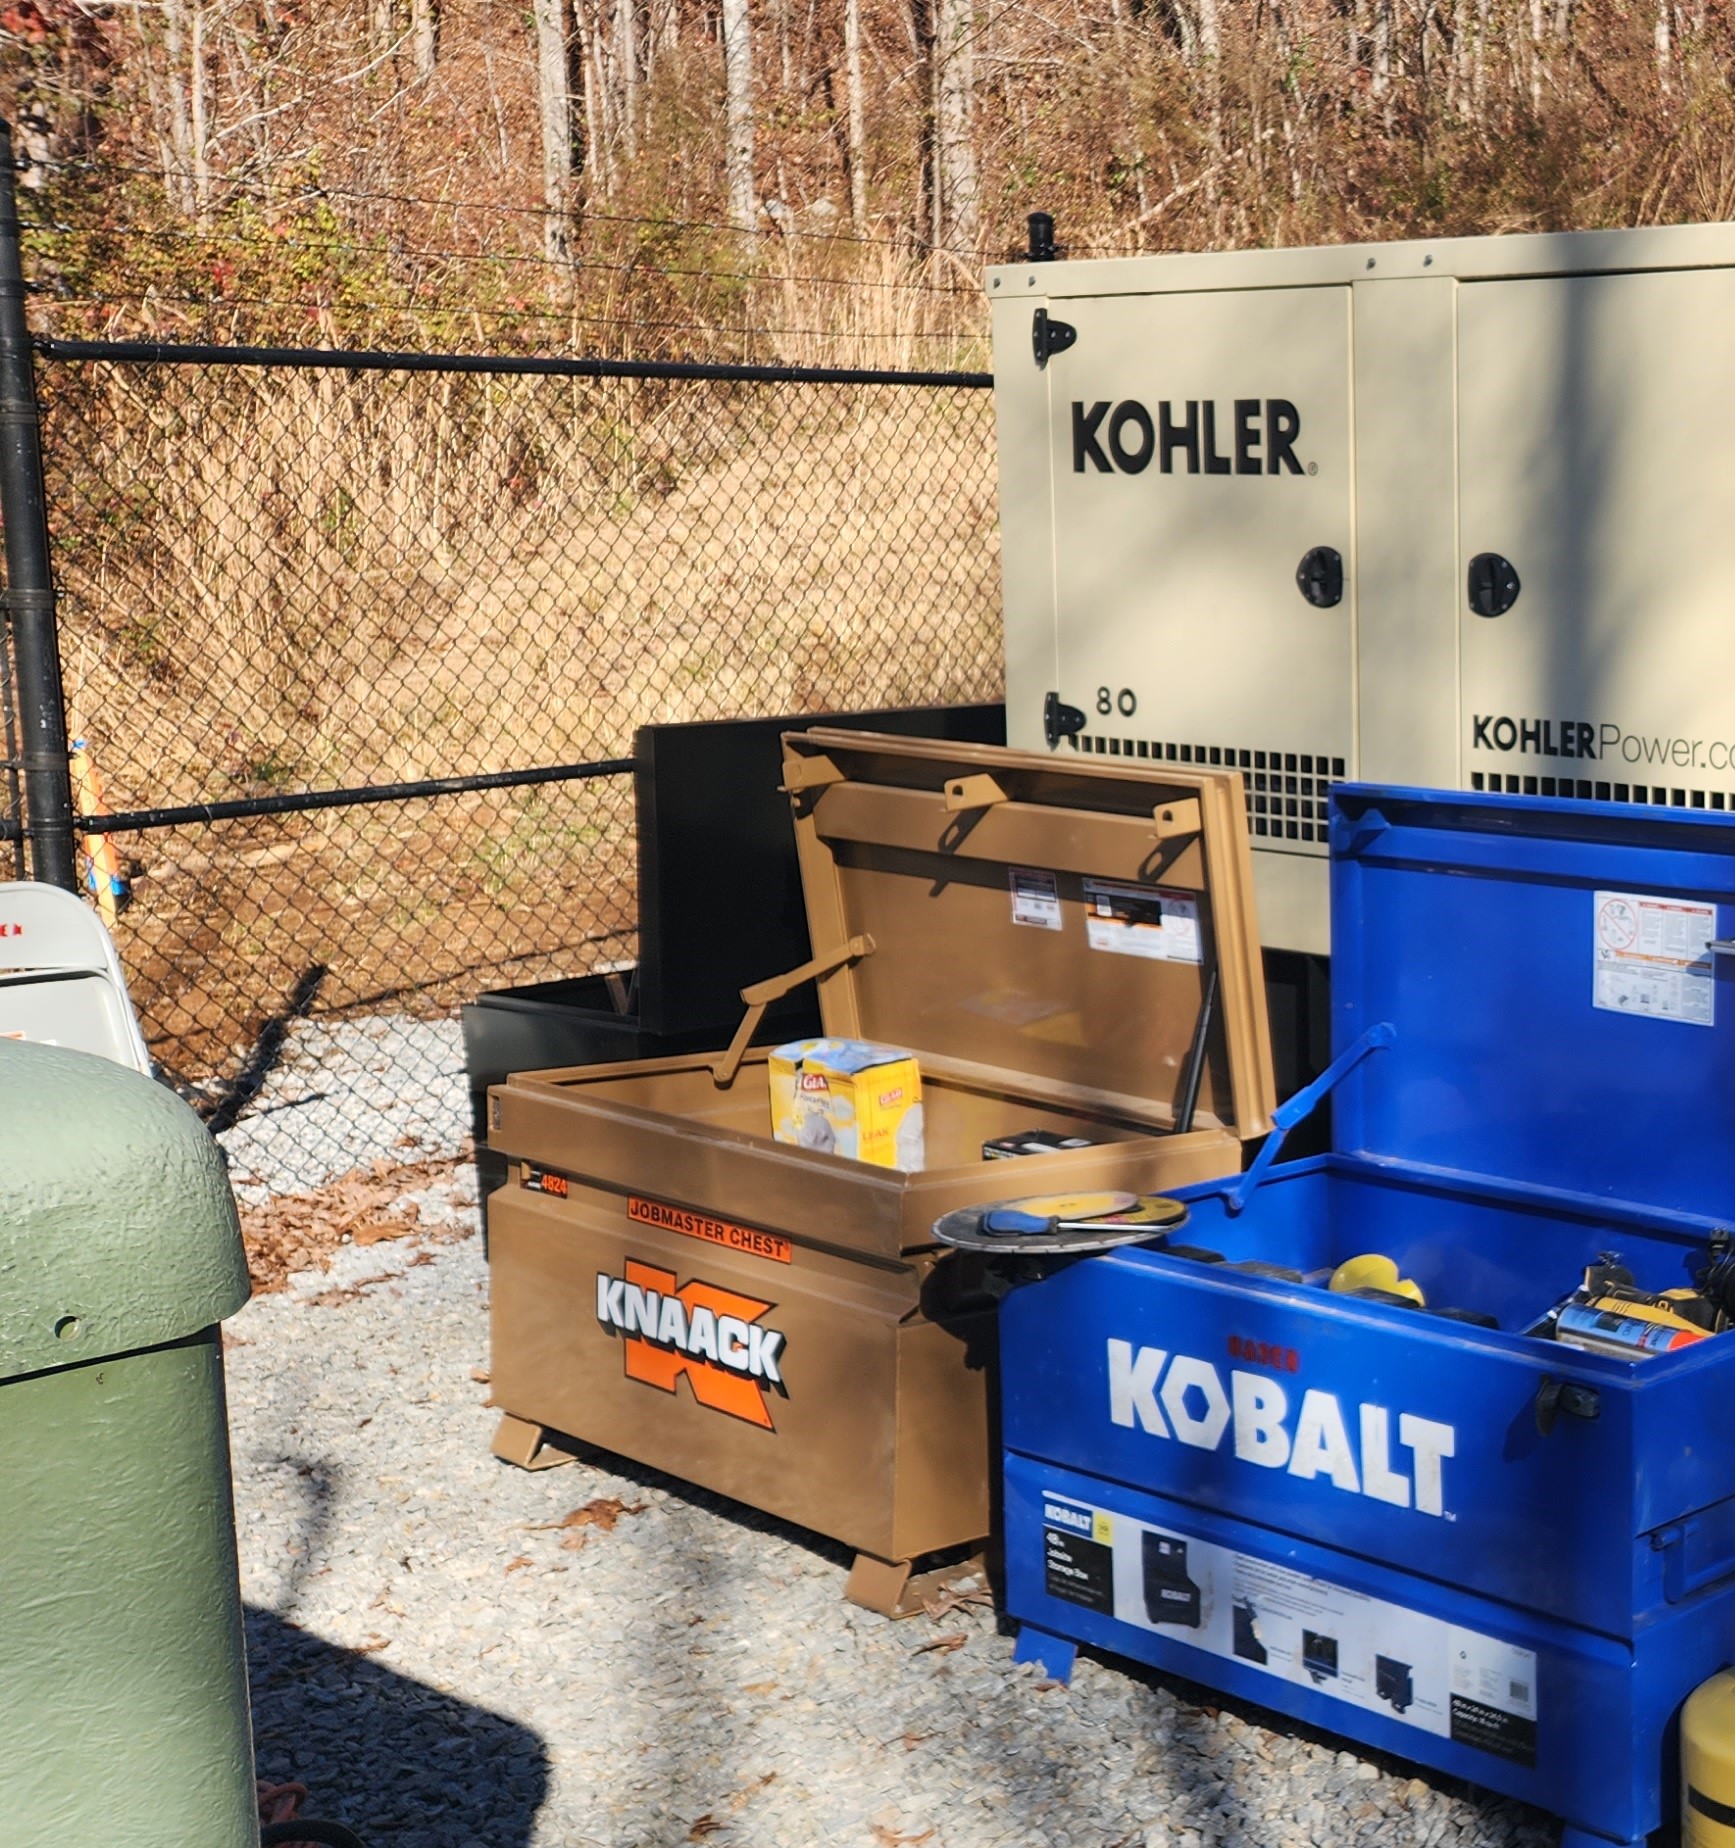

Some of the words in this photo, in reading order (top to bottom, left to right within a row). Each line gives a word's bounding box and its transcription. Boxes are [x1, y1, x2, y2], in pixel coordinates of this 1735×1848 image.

[1071, 398, 1307, 476] KOHLER
[1096, 685, 1138, 717] 80
[541, 1174, 568, 1195] 4824
[630, 1200, 725, 1243] JOBMASTER
[729, 1226, 785, 1258] CHEST
[596, 1272, 788, 1400] KNAACK
[1106, 1338, 1455, 1517] KOBALT
[1044, 1503, 1092, 1532] KOBALT
